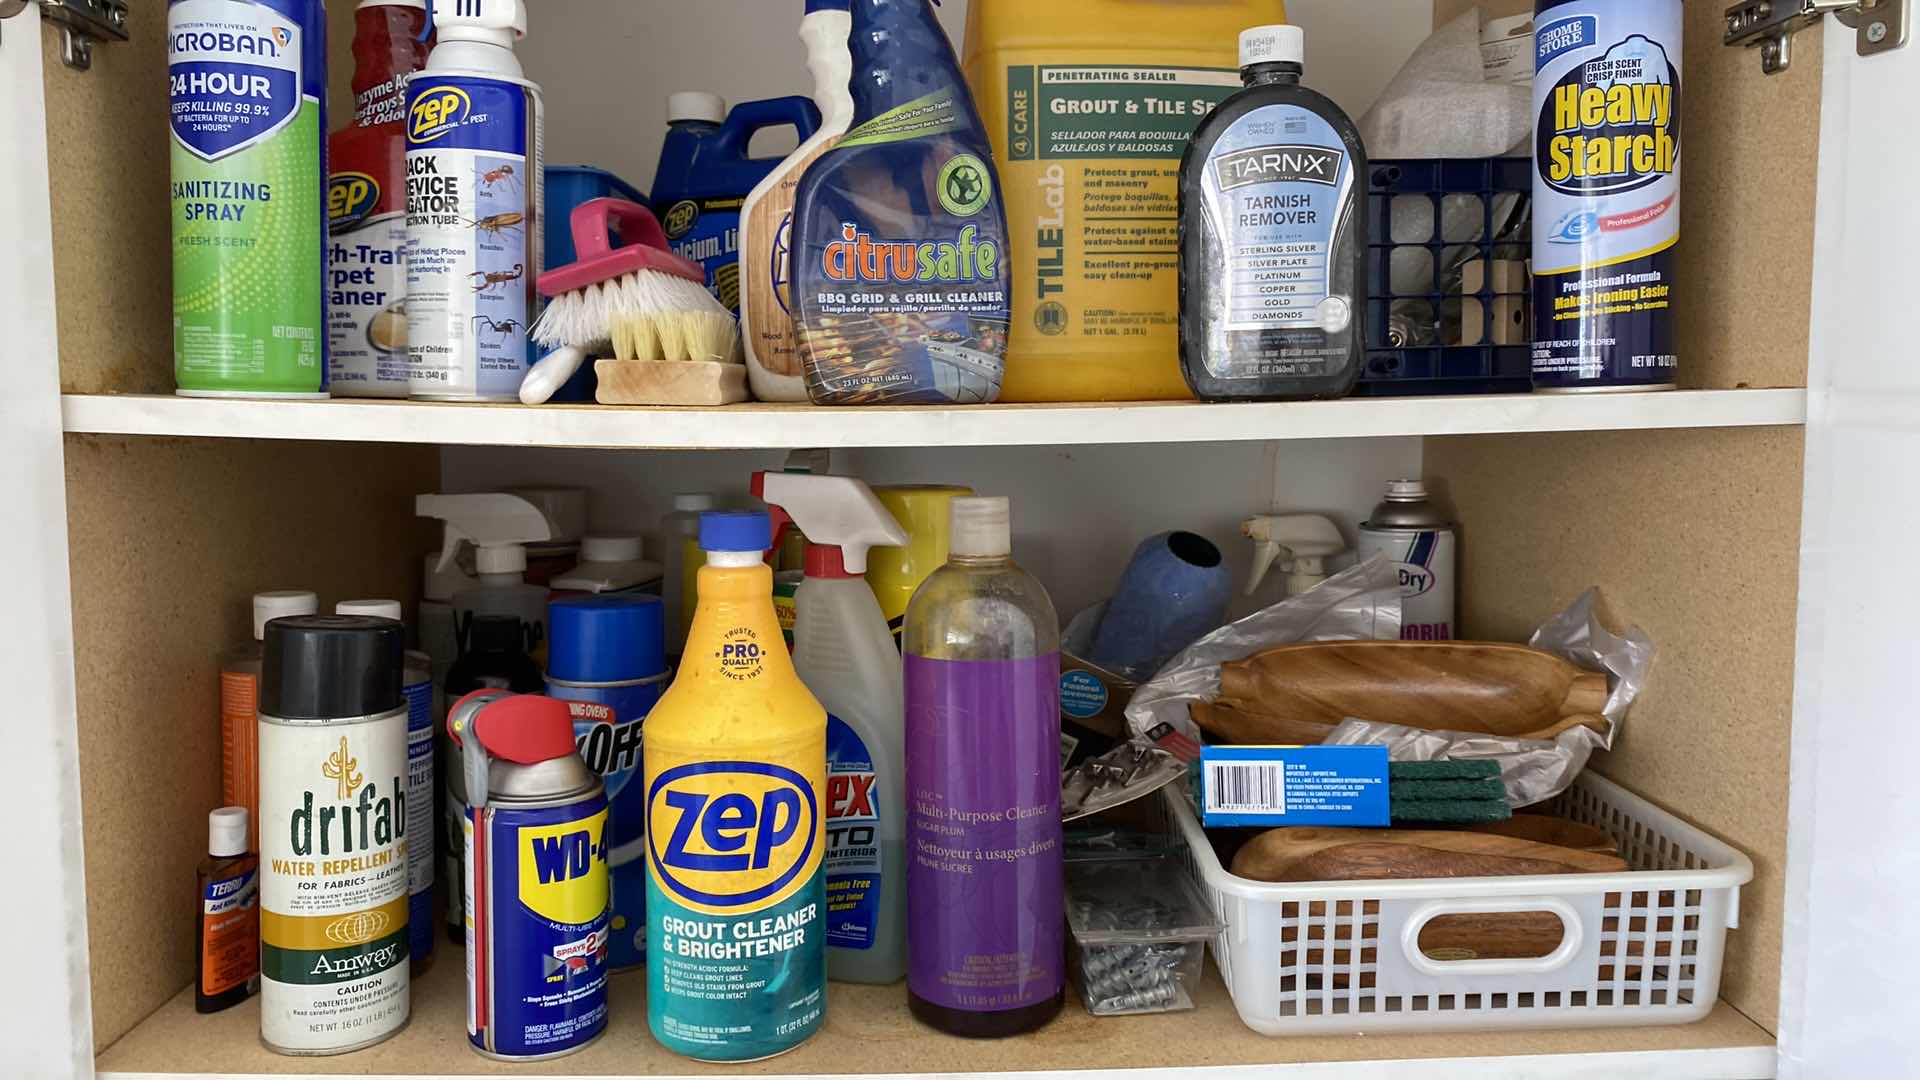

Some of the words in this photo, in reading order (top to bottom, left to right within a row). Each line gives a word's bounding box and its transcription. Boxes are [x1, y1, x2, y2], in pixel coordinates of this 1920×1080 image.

[224, 23, 244, 31] LIVES
[1547, 20, 1582, 41] HOME
[1539, 31, 1583, 57] STORE
[1587, 60, 1614, 73] FRESH
[1615, 59, 1642, 69] SCENT
[1048, 72, 1129, 81] PENETRATING
[1133, 72, 1176, 81] SEALER
[1587, 71, 1614, 83] CRISP
[1615, 69, 1642, 79] FINISH
[170, 73, 186, 96] 24
[190, 72, 272, 99] HOUR
[191, 102, 232, 113] KILLING
[234, 103, 270, 116] 99.9%
[1014, 89, 1027, 134] CARE
[1050, 98, 1119, 115] GROUT
[1125, 100, 1139, 115] &
[1143, 98, 1186, 115] TILE
[1554, 83, 1673, 132] Heavy
[470, 113, 488, 123] PEST
[192, 123, 202, 131] 24
[1051, 131, 1106, 140] SELLADOR
[1109, 131, 1136, 140] PARA
[1050, 143, 1105, 153] AZULEJOS
[1108, 143, 1116, 152] Y
[1117, 143, 1174, 153] BALDOSAS
[1549, 127, 1674, 183] Starch
[406, 156, 438, 176] ACK
[1084, 168, 1127, 177] Protects
[1130, 169, 1160, 178] grout,
[173, 180, 271, 202] SANITIZING
[406, 177, 458, 195] EVICE
[1105, 181, 1148, 189] masonry
[329, 180, 369, 218] ep
[1084, 193, 1122, 202] Protege
[1244, 195, 1311, 210] TARNISH
[406, 196, 460, 214] GATOR
[1083, 204, 1127, 212] baldosas
[1130, 204, 1144, 212] sin
[185, 203, 246, 222] SPRAY
[1240, 211, 1316, 227] REMOVER
[431, 215, 460, 225] TUBE
[1607, 213, 1649, 227] Professional
[1084, 227, 1127, 235] Protects
[1130, 227, 1167, 236] against
[180, 236, 211, 246] FRESH
[214, 237, 258, 248] SCENT
[673, 236, 723, 262] alcium,
[725, 228, 739, 253] Li
[1084, 238, 1146, 246] water-based
[441, 248, 466, 257] Places
[823, 223, 997, 281] citrusafe
[1240, 246, 1283, 255] STERLING
[1084, 261, 1131, 269] Excellent
[1280, 258, 1308, 266] PLATE
[329, 267, 375, 288] pet
[1084, 272, 1106, 281] easy
[1110, 271, 1152, 281] clean-up
[1254, 272, 1301, 280] PLATINUM
[1563, 275, 1624, 293] Professional
[1626, 271, 1661, 283] Formula
[329, 291, 386, 306] aner
[818, 293, 846, 304] BBQ
[851, 293, 885, 303] GRID
[889, 293, 900, 303] &
[905, 293, 943, 303] GRILL
[947, 291, 1004, 303] CLEANER
[1555, 294, 1591, 310] Makes
[1593, 289, 1638, 304] Ironing
[1640, 285, 1669, 298] Easier
[822, 305, 866, 313] Limpiador
[1252, 312, 1303, 320] DIAMONDS
[426, 345, 453, 354] Children
[1631, 355, 1644, 367] NET
[1645, 355, 1655, 367] WT
[1398, 568, 1426, 591] Dry
[724, 628, 757, 640] TRUSTED
[1401, 623, 1449, 641] ORIA
[722, 643, 760, 658] PRO
[722, 658, 760, 666] QUALITY
[719, 667, 744, 681] SINCE
[747, 665, 764, 680] 1937
[1073, 675, 1090, 684] For
[1063, 683, 1100, 692] Fastest
[585, 704, 608, 719] OVENS
[826, 773, 875, 817] ex
[290, 776, 406, 856] drifab
[916, 801, 1003, 825] Multi-Purpose
[1006, 803, 1049, 820] Cleaner
[662, 787, 801, 872] Zep
[826, 826, 874, 847] TO
[940, 827, 965, 837] PLUM
[532, 817, 608, 885] WD-4
[826, 848, 877, 859] INTERIOR
[917, 839, 972, 860] Nettoyeur
[975, 847, 983, 860] à
[985, 847, 1026, 863] usages
[272, 859, 315, 876] WATER
[323, 850, 392, 875] REPELLENT
[297, 882, 318, 890] FOR
[324, 877, 366, 890] FABRICS
[852, 879, 870, 889] Free
[549, 922, 592, 932] MULTI-USE
[663, 916, 727, 940] GROUT
[733, 903, 817, 939] CLEANER
[556, 943, 586, 957] SPRAYS
[663, 935, 674, 953] &
[678, 929, 805, 960] BRIGHTENER
[310, 943, 397, 975] Amway
[699, 965, 717, 973] ACIDIC
[337, 979, 382, 996] CAUTION
[706, 983, 727, 991] STAINS
[745, 980, 766, 989] GROUT
[313, 999, 348, 1009] CONTENTS
[349, 993, 372, 1005] UNDER
[686, 990, 705, 999] GROUT
[705, 992, 725, 1000] COLOR
[309, 1008, 337, 1017] carefully
[309, 1024, 324, 1033] NET
